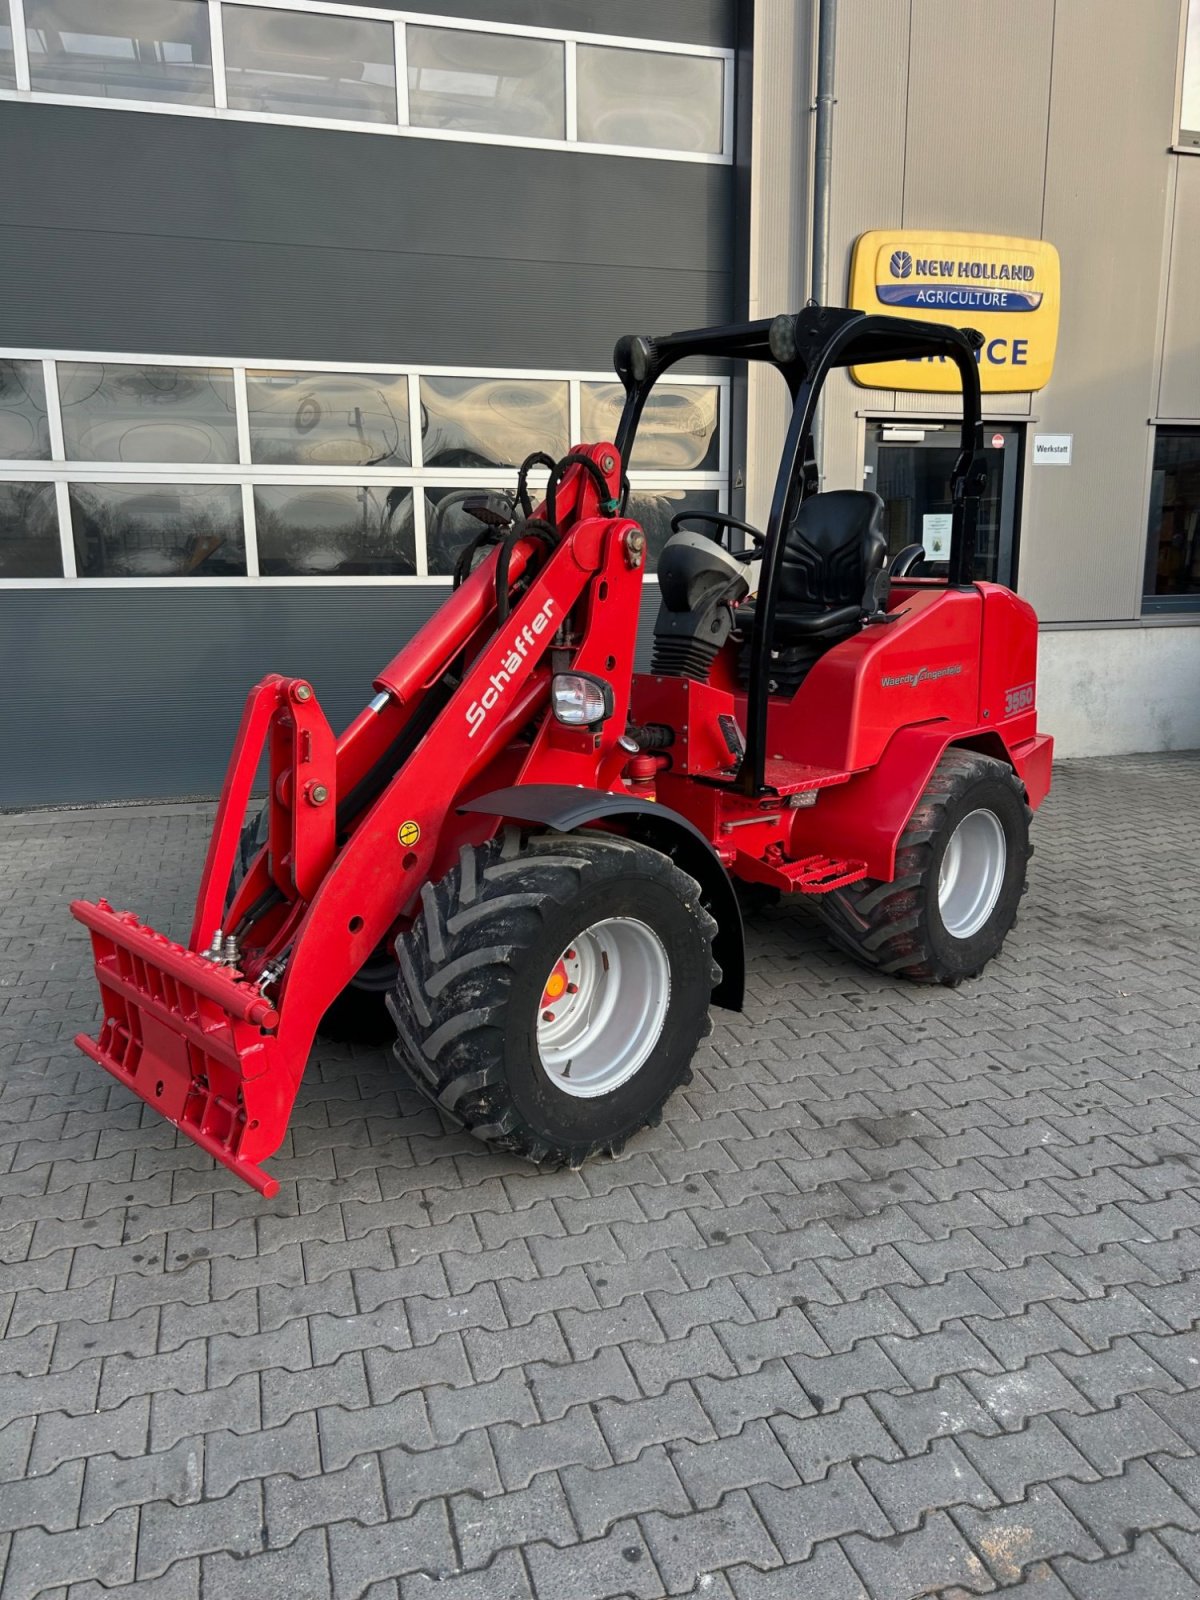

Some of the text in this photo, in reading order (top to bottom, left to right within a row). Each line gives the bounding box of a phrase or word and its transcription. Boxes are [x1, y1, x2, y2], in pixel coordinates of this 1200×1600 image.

[916, 260, 1034, 281] NEW HOLLAND
[916, 290, 1008, 306] AGRICULTURE
[1036, 445, 1068, 453] Werkstatt
[465, 598, 554, 738] Schäffer
[1005, 687, 1033, 713] 3550
